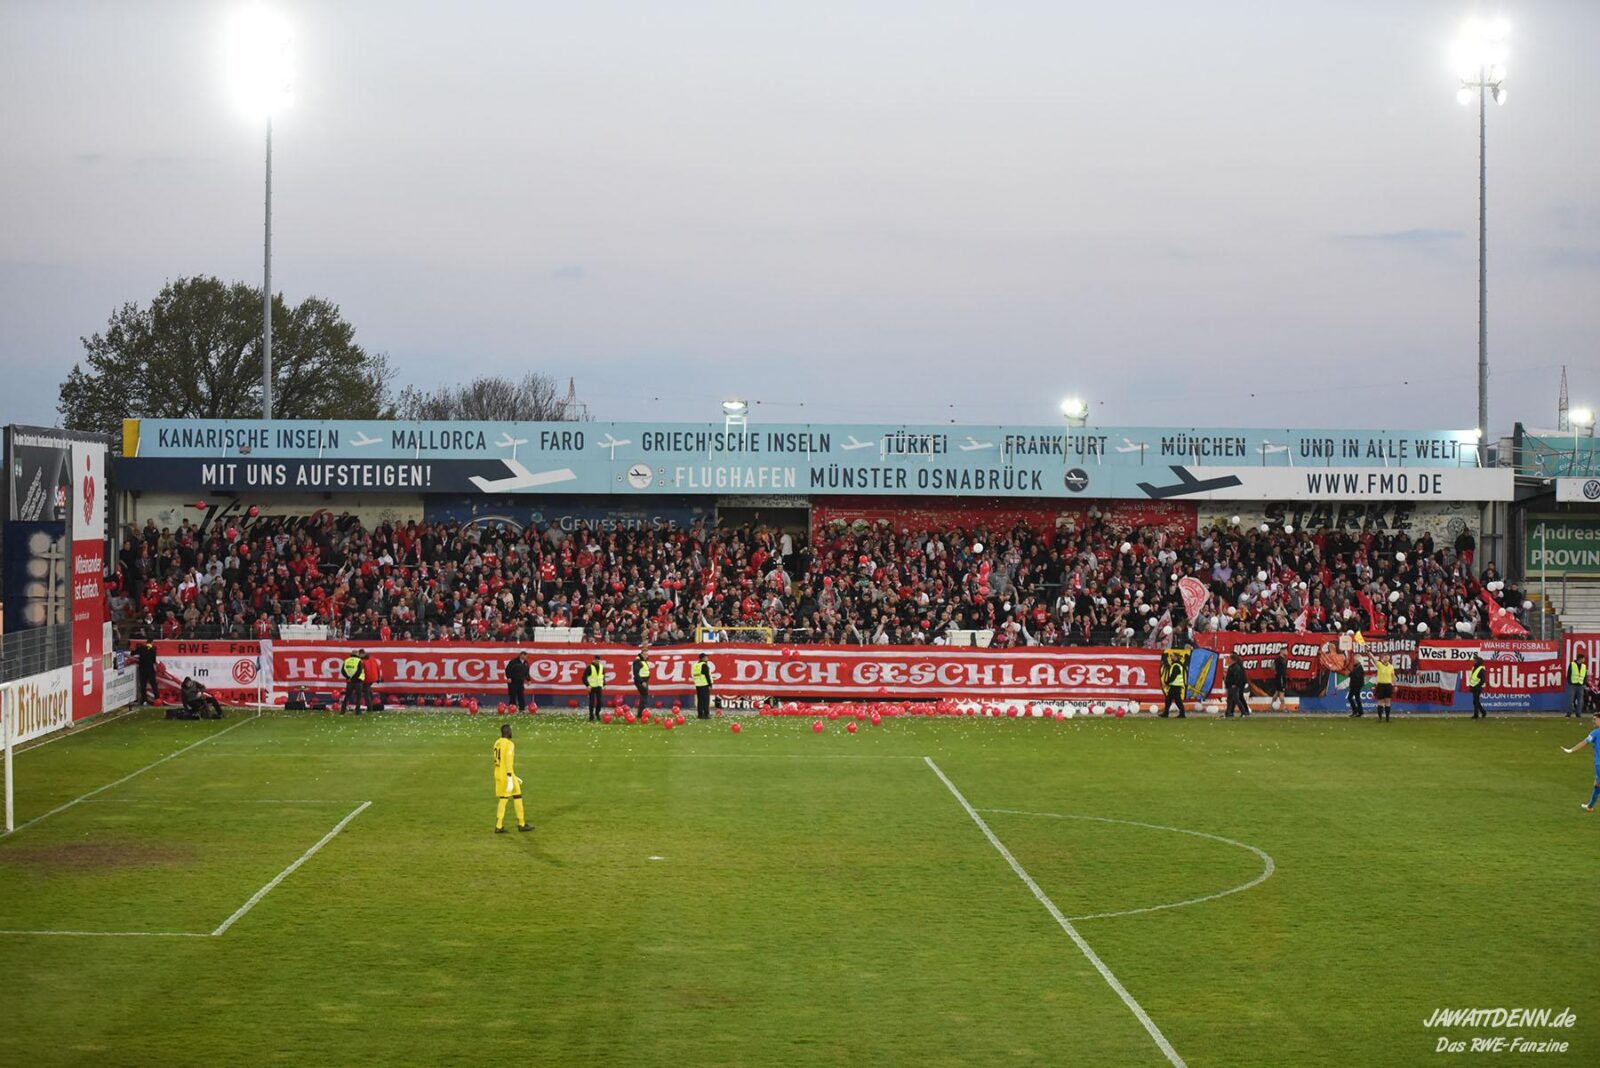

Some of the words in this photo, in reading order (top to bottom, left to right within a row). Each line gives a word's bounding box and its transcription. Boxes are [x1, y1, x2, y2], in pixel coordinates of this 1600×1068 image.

[159, 428, 269, 449] KANARISCHE
[277, 429, 340, 450] INSELN
[392, 430, 486, 450] MALLORCA
[540, 431, 585, 451] FARO
[642, 432, 760, 452] GRIECHISCHE
[768, 433, 831, 453] INSELN
[884, 430, 948, 454] TÜRKEI
[1005, 435, 1108, 456] FRANKFURT
[1161, 435, 1247, 457] MÜNCHEN
[1300, 438, 1334, 458] UND
[1343, 438, 1359, 458] IN
[1366, 438, 1408, 459] ALLE
[1414, 439, 1458, 459] WELT
[202, 464, 237, 485] MIT
[247, 464, 286, 486] UNS
[296, 464, 432, 487] AUFSTEIGEN!
[675, 467, 796, 488] FLUGHAFEN
[810, 463, 907, 489] MÜNSTER
[917, 465, 1043, 491] OSNABRÜCK
[1307, 473, 1442, 495] WWW.FMO.DE
[653, 517, 676, 532] SE
[1532, 524, 1600, 540] Andreas
[178, 644, 209, 654] RWE
[230, 643, 261, 654] Fans
[1292, 645, 1319, 656] CREW
[1420, 648, 1446, 659] West
[1451, 649, 1479, 661] Boys
[193, 667, 209, 677] im
[284, 657, 383, 679] HA
[731, 660, 841, 684] DICH
[852, 662, 1150, 687] GESCHLAGEN
[1287, 660, 1311, 670] ESSEN
[18, 683, 68, 736] Bitburger
